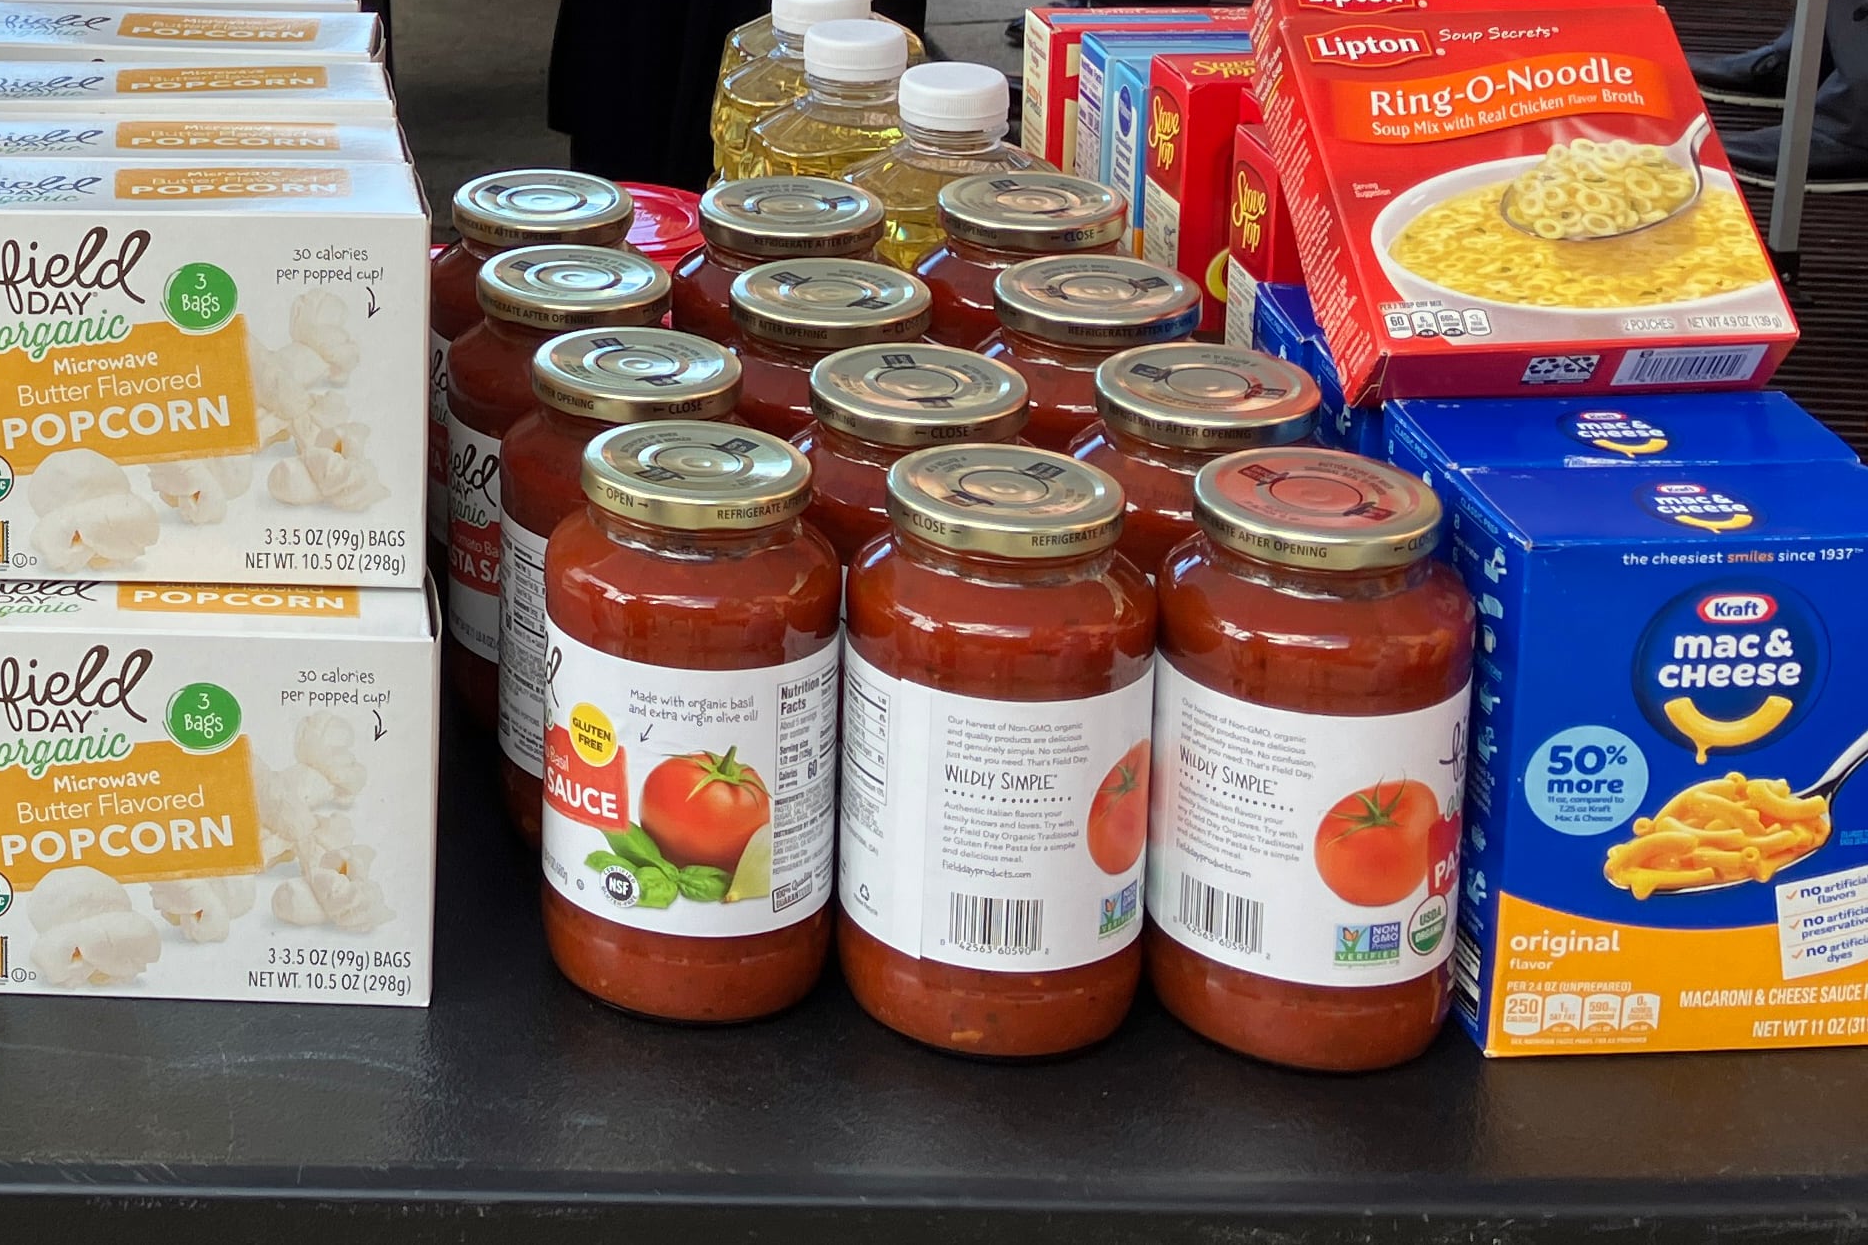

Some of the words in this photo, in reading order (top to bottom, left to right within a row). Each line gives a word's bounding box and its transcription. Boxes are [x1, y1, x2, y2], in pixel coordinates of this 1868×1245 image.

[1316, 32, 1420, 60] Lipton
[1439, 27, 1482, 43] Soup
[1369, 58, 1634, 120] Ring-O-Noodle
[1371, 120, 1410, 140] Soup
[1414, 118, 1439, 135] Mix
[1443, 114, 1471, 131] with
[1478, 107, 1507, 126] Real
[1509, 94, 1564, 119] Chicken
[1568, 94, 1598, 106] Flavor
[1601, 88, 1645, 107] Broth
[292, 248, 312, 261] 30
[315, 247, 368, 261] calories
[195, 273, 207, 289] 3
[277, 268, 298, 283] per
[303, 266, 352, 284] popped
[355, 266, 383, 282] cup!
[25, 292, 91, 316] DAY
[181, 293, 221, 319] Bags
[53, 350, 158, 376] Microwave
[18, 375, 95, 407] Butter
[99, 366, 202, 399] Flavored
[1, 395, 231, 450] POPCORN
[606, 488, 634, 507] OPEN
[716, 501, 781, 521] REFRIGERATE
[912, 513, 946, 535] CLOSE
[304, 530, 323, 546] OZ
[326, 529, 365, 550] (99g)
[368, 530, 406, 547] BAGS
[245, 553, 270, 569] NET
[272, 553, 298, 569] WT.
[301, 554, 333, 570] 10.5
[337, 554, 356, 571] OZ
[358, 554, 406, 575] (298g)
[1623, 553, 1648, 566] the
[1652, 551, 1723, 565] cheesiest
[1727, 550, 1774, 563] smiles
[1777, 549, 1815, 562] since
[1714, 599, 1759, 617] Kraft
[1674, 633, 1760, 659] mac
[1764, 628, 1794, 658] &
[297, 669, 318, 684] 30
[320, 669, 375, 684] calories
[197, 693, 210, 710] 3
[281, 690, 303, 706] per
[308, 689, 358, 707] popped
[361, 688, 390, 704] cup!
[630, 689, 658, 705] Made
[661, 694, 684, 707] with
[688, 697, 728, 714] organic
[730, 694, 754, 709] basil
[25, 710, 93, 733] DAY
[184, 712, 224, 739] Bags
[628, 704, 648, 716] and
[650, 706, 678, 721] extra
[681, 711, 713, 726] virgin
[716, 712, 741, 723] olive
[573, 717, 612, 742] GLUTEN
[578, 733, 603, 754] FREE
[1547, 745, 1628, 775] 50%
[53, 769, 160, 794] Microwave
[547, 766, 618, 820] SAUCE
[1547, 779, 1624, 794] more
[17, 795, 95, 825] Butter
[99, 786, 205, 817] Flavored
[1, 815, 234, 866] POPCORN
[1510, 930, 1621, 957] original
[309, 949, 328, 966] OZ
[331, 949, 370, 970] (99g)
[374, 951, 411, 968] BAGS
[1509, 959, 1554, 971] flavor
[248, 970, 273, 988] NET
[276, 971, 302, 989] WT.
[305, 973, 338, 990] 10.5
[341, 974, 361, 991] OZ
[363, 975, 411, 995] (298g)
[1679, 988, 1752, 1007] MACARONI
[1755, 989, 1765, 1006] &
[1768, 986, 1818, 1004] CHEESE
[1820, 984, 1863, 1003] SAUCE
[1752, 1020, 1781, 1038] NET
[1783, 1019, 1807, 1036] WT
[1811, 1020, 1824, 1035] 11
[1827, 1018, 1845, 1035] OZ
